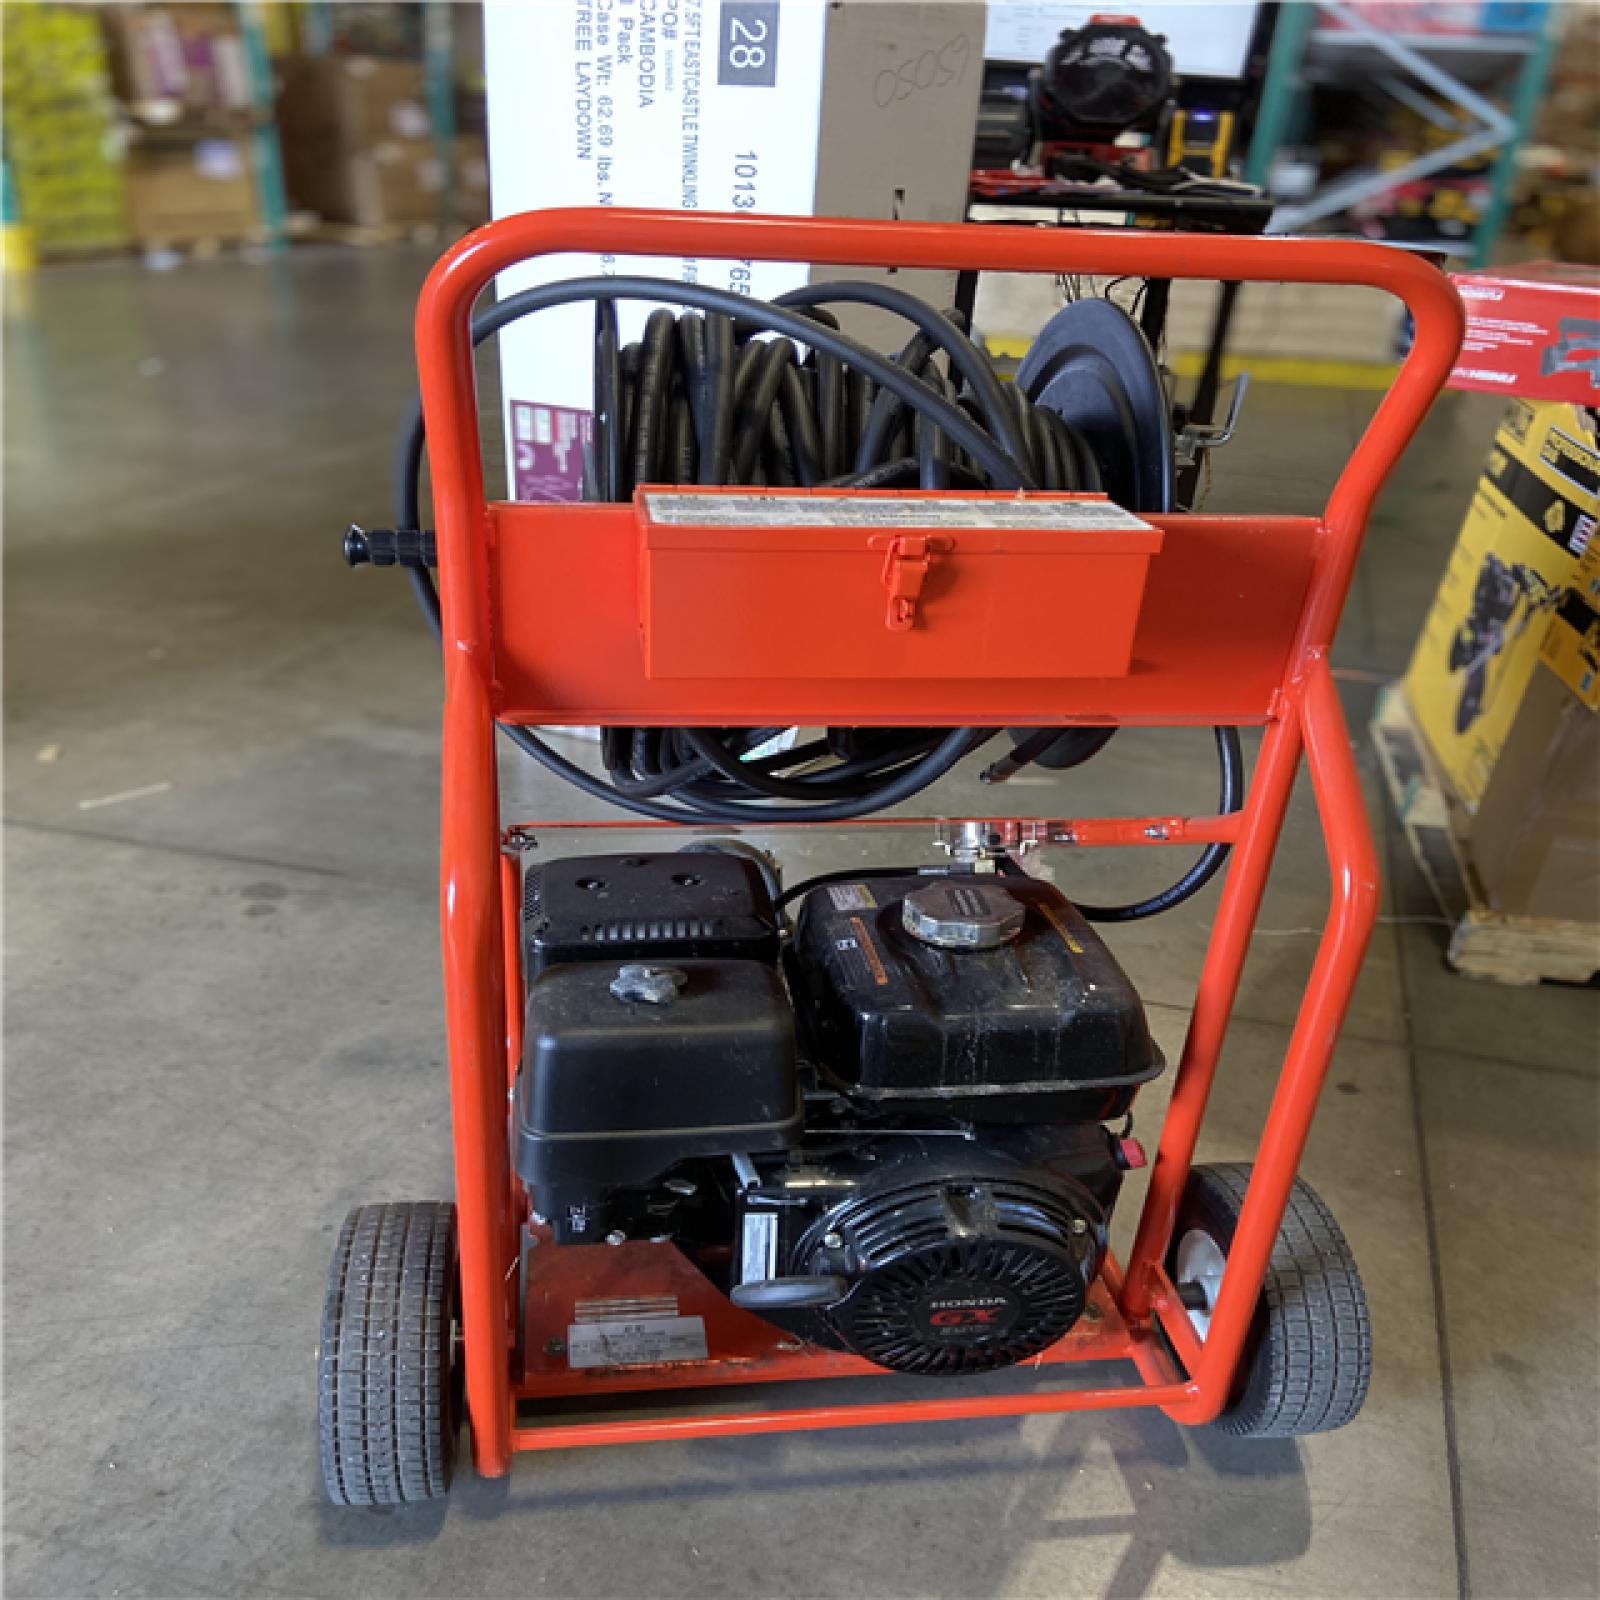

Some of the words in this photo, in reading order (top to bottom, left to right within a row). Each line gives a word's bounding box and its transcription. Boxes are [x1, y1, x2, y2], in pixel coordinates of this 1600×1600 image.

[574, 0, 593, 51] TREE
[596, 0, 613, 45] Case
[616, 17, 634, 64] Pack
[729, 19, 768, 69] 28
[638, 0, 656, 108] CAMBODIA
[574, 62, 592, 160] LAYDOWN
[682, 40, 701, 131] EASTCASTLE
[681, 134, 699, 208] TWINKLING
[732, 151, 758, 212] 1013
